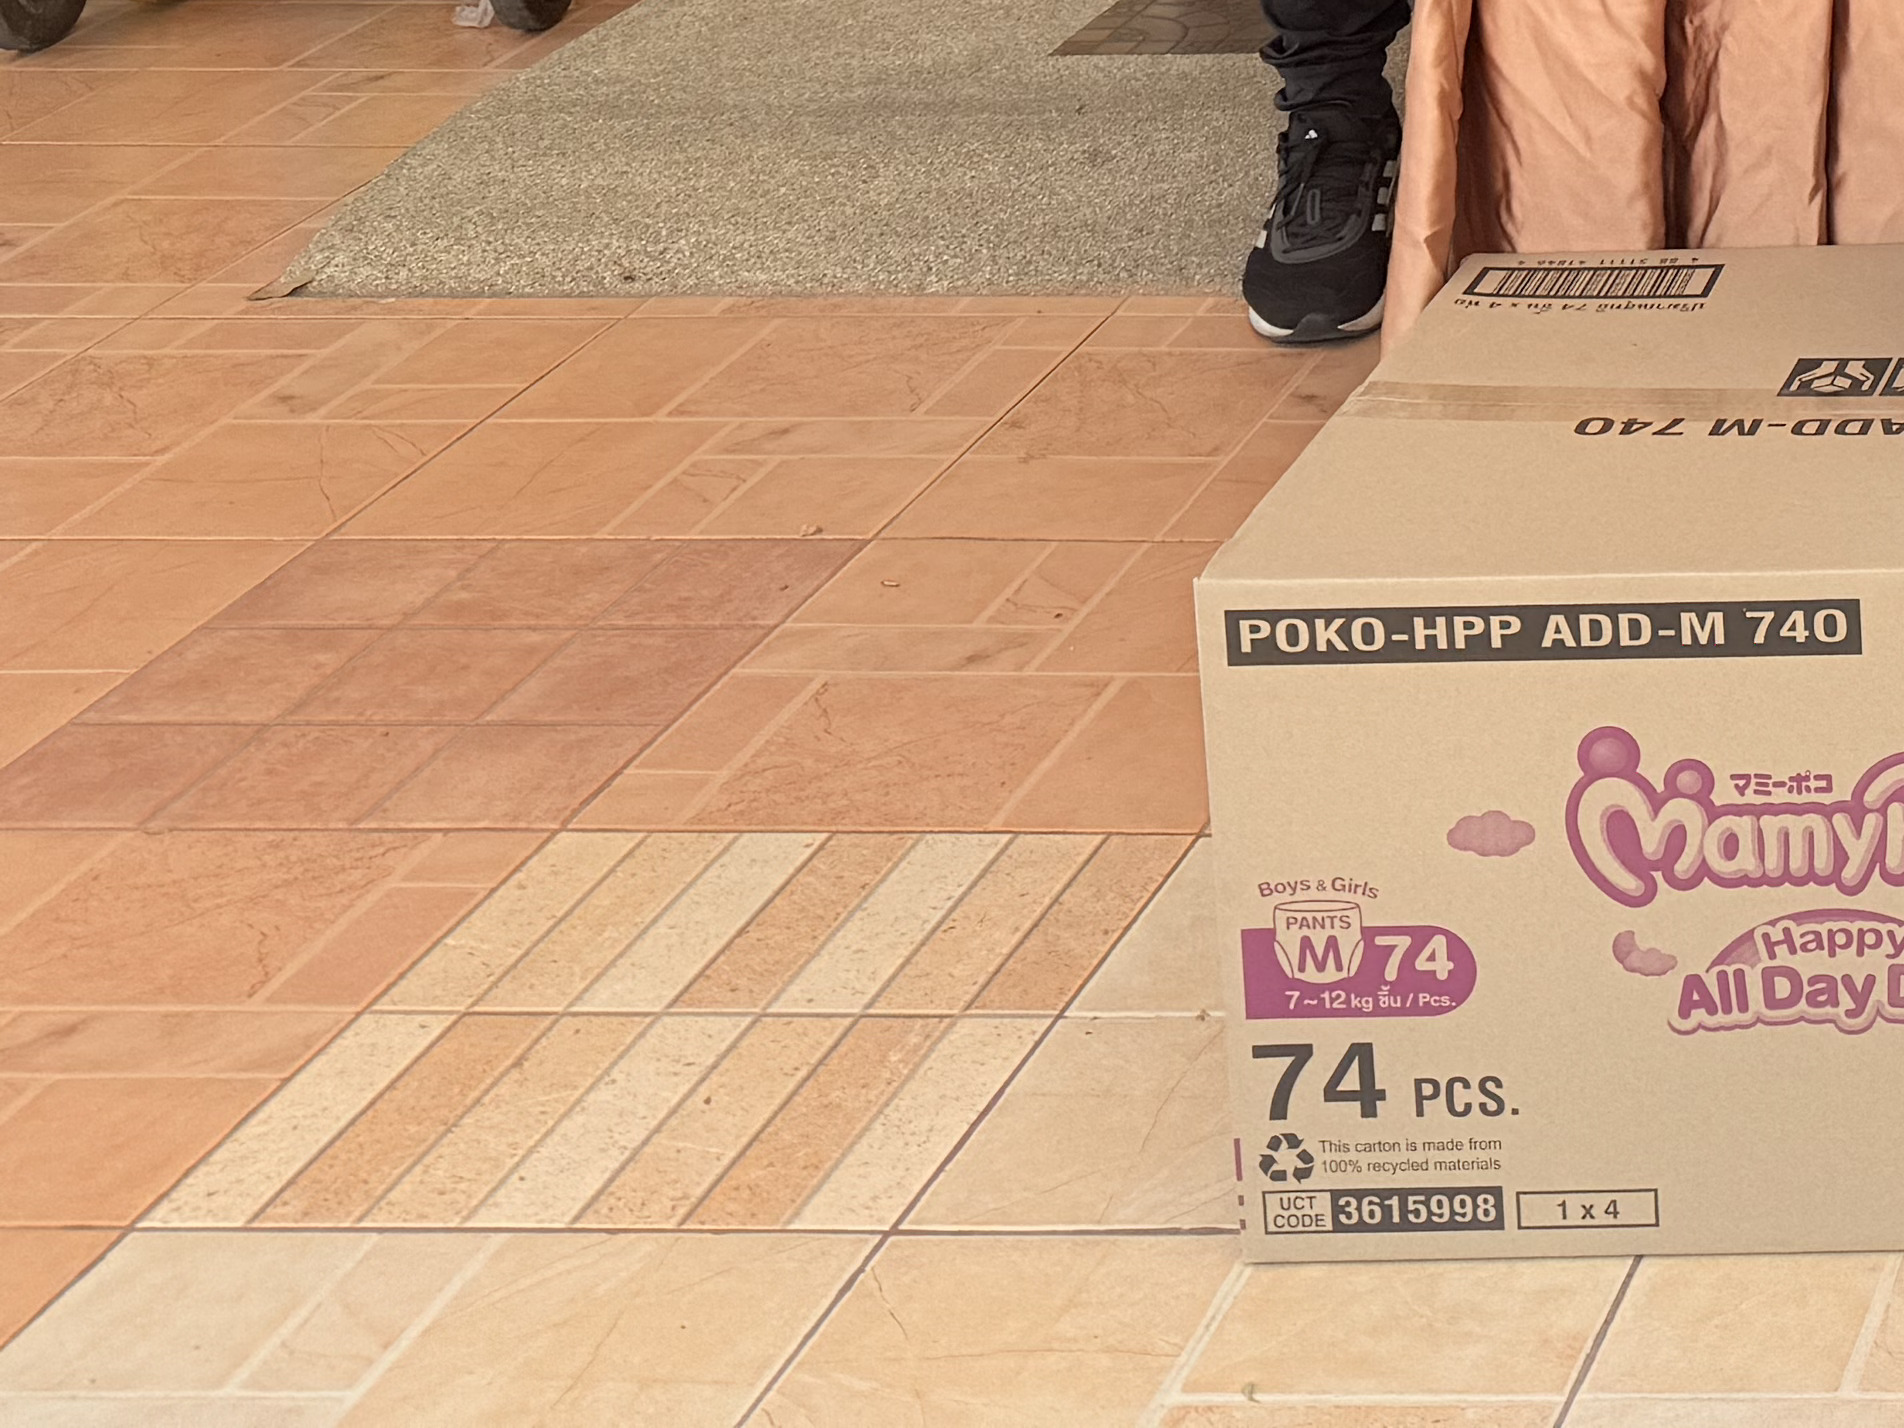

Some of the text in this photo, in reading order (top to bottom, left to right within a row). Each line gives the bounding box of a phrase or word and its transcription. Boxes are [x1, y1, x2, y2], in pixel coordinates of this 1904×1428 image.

[1238, 609, 1848, 654] POKO-HPP ADD-M 740
[1251, 1042, 1520, 1121] 74 PCS.
[1318, 1136, 1503, 1155] This carton is made from
[1321, 1157, 1502, 1176] 100% recycled materials
[1337, 1192, 1498, 1225] 3615998
